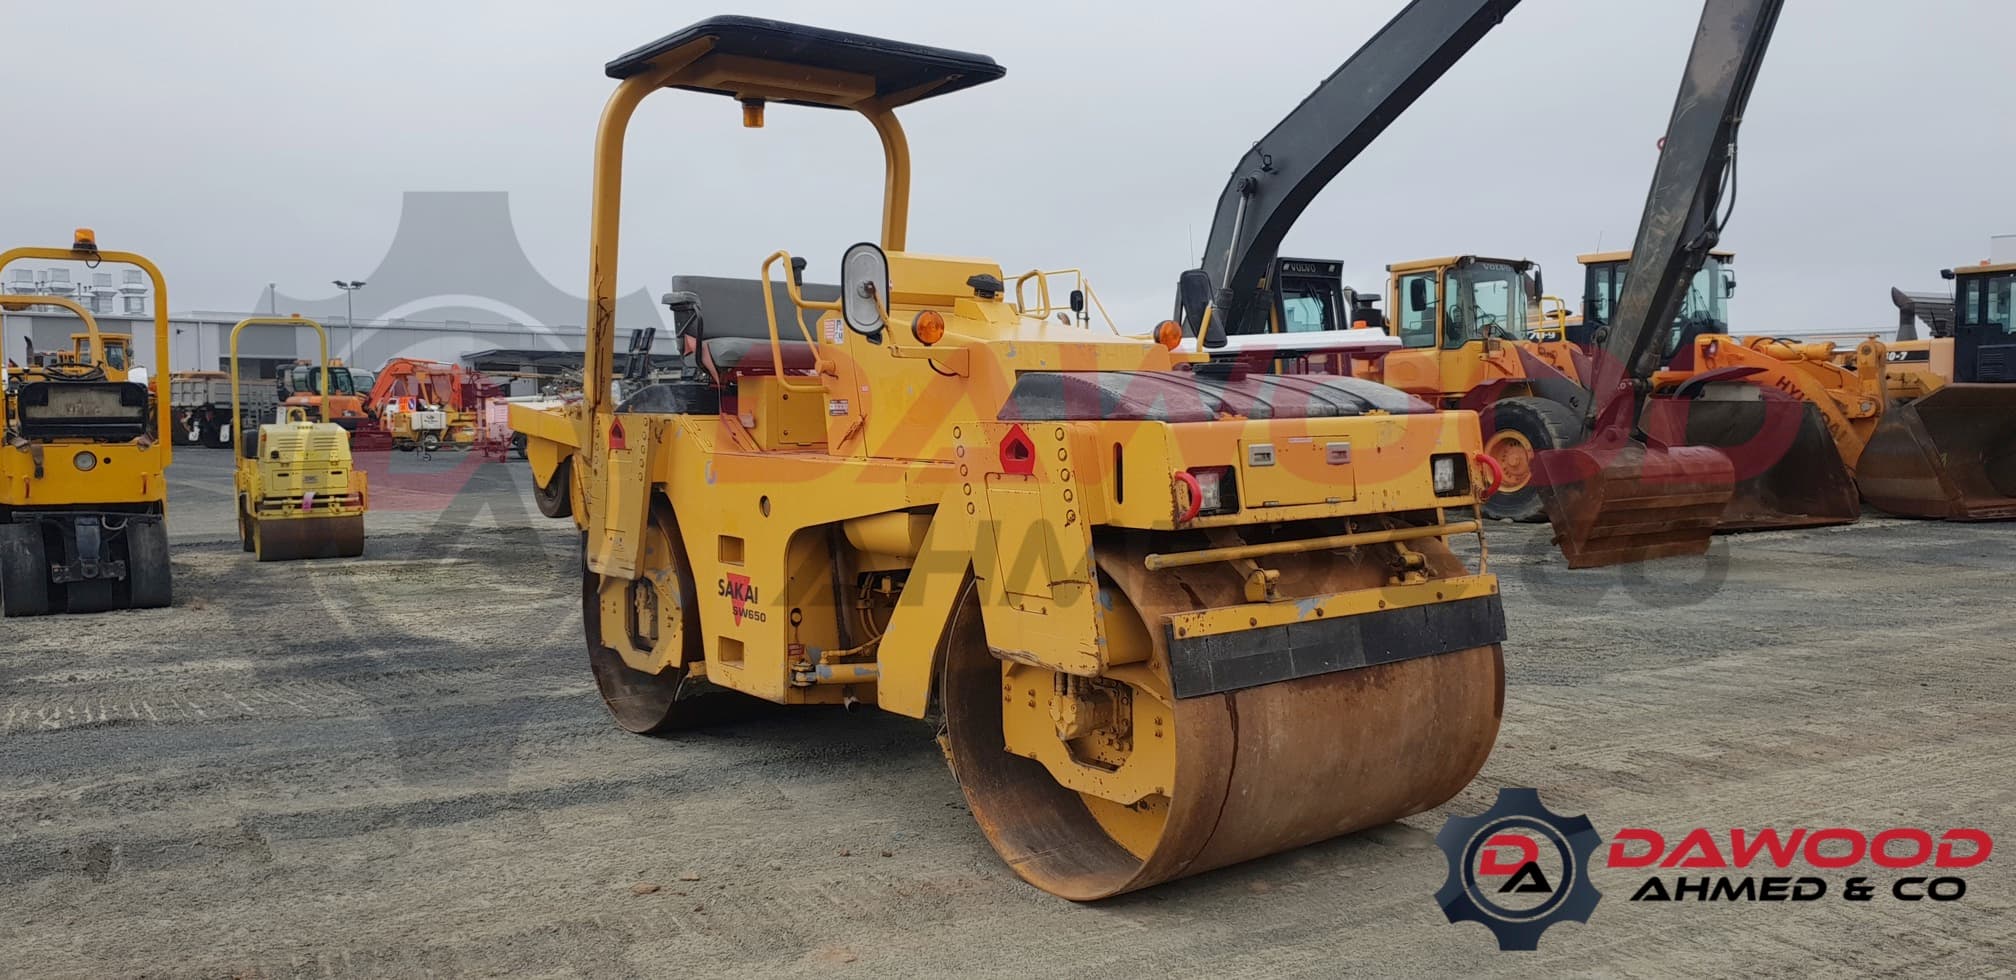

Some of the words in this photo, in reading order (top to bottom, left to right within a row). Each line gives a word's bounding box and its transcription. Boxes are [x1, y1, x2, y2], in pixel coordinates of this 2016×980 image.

[1290, 263, 1317, 273] VOLVO
[718, 578, 758, 605] SAKAI
[732, 606, 767, 623] SW650
